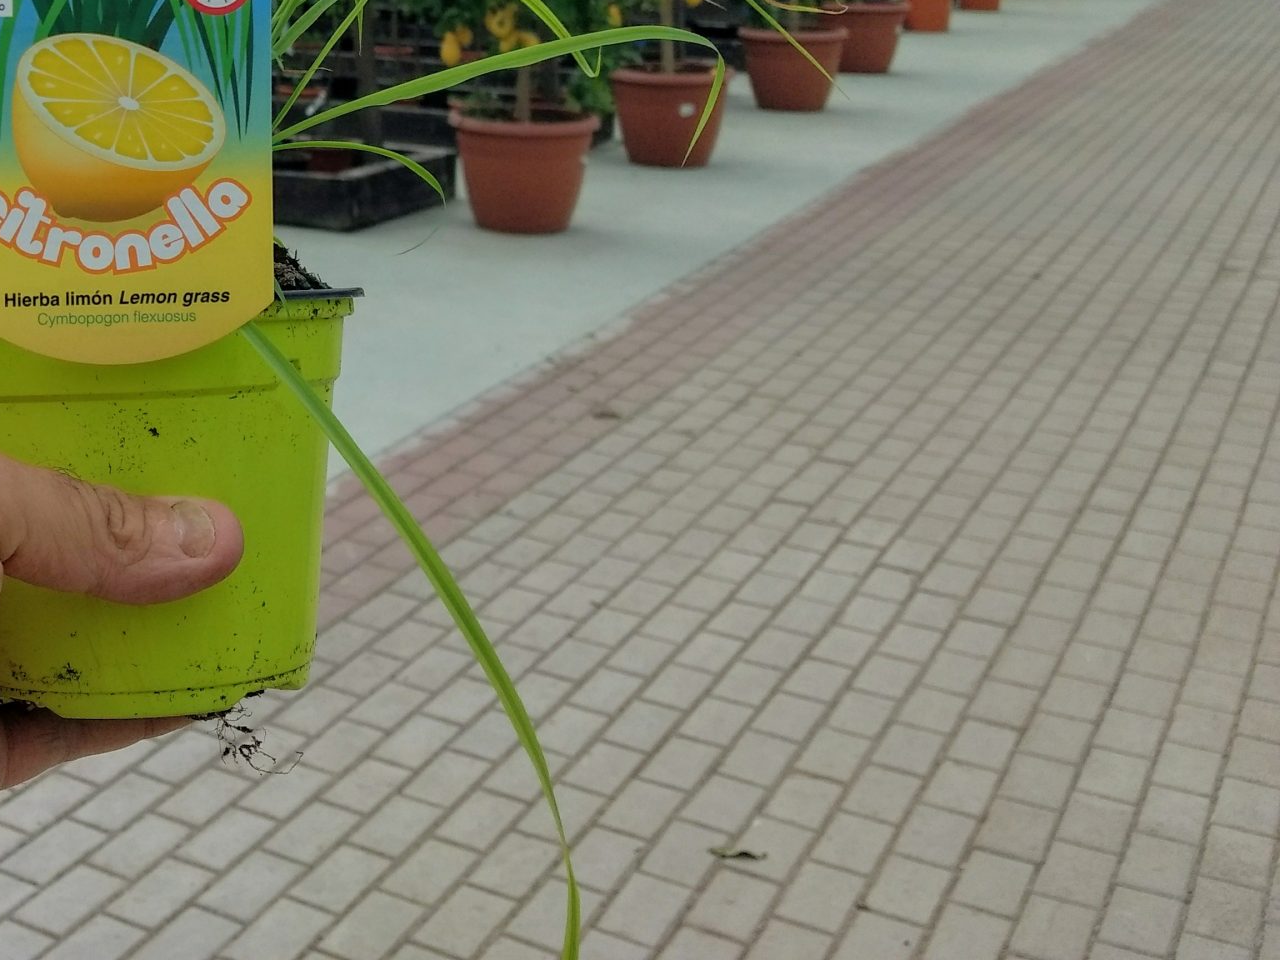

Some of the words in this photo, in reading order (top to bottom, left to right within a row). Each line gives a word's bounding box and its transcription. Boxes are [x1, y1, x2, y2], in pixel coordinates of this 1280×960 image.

[3, 291, 61, 308] Hierba
[65, 289, 113, 306] limón
[118, 290, 177, 306] Lemon
[182, 290, 231, 307] grass
[37, 311, 129, 328] Cymbopogon
[133, 309, 196, 323] flexuosus
